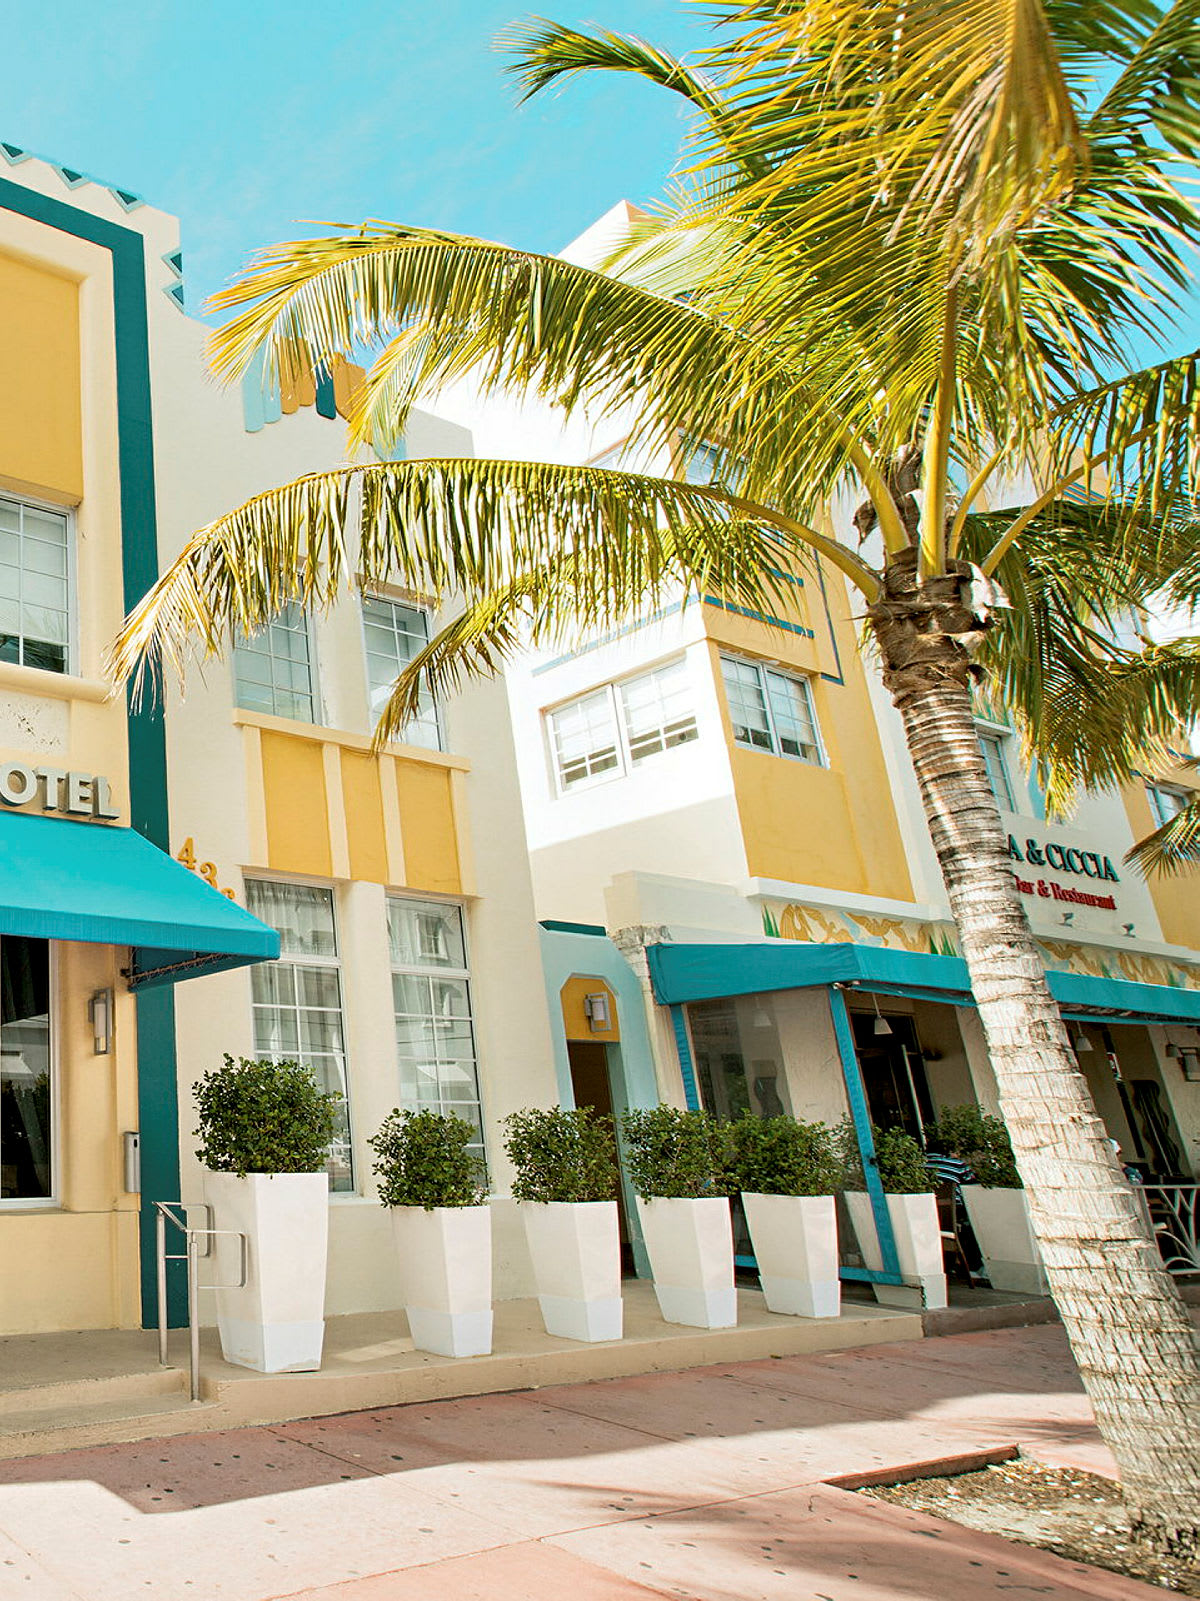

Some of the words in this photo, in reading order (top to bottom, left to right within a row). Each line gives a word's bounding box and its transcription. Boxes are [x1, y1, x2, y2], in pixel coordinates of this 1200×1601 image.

[1026, 838, 1047, 867] &
[1045, 843, 1121, 882] CICCIA
[1036, 879, 1051, 898] &
[1049, 881, 1118, 911] Restaurant
